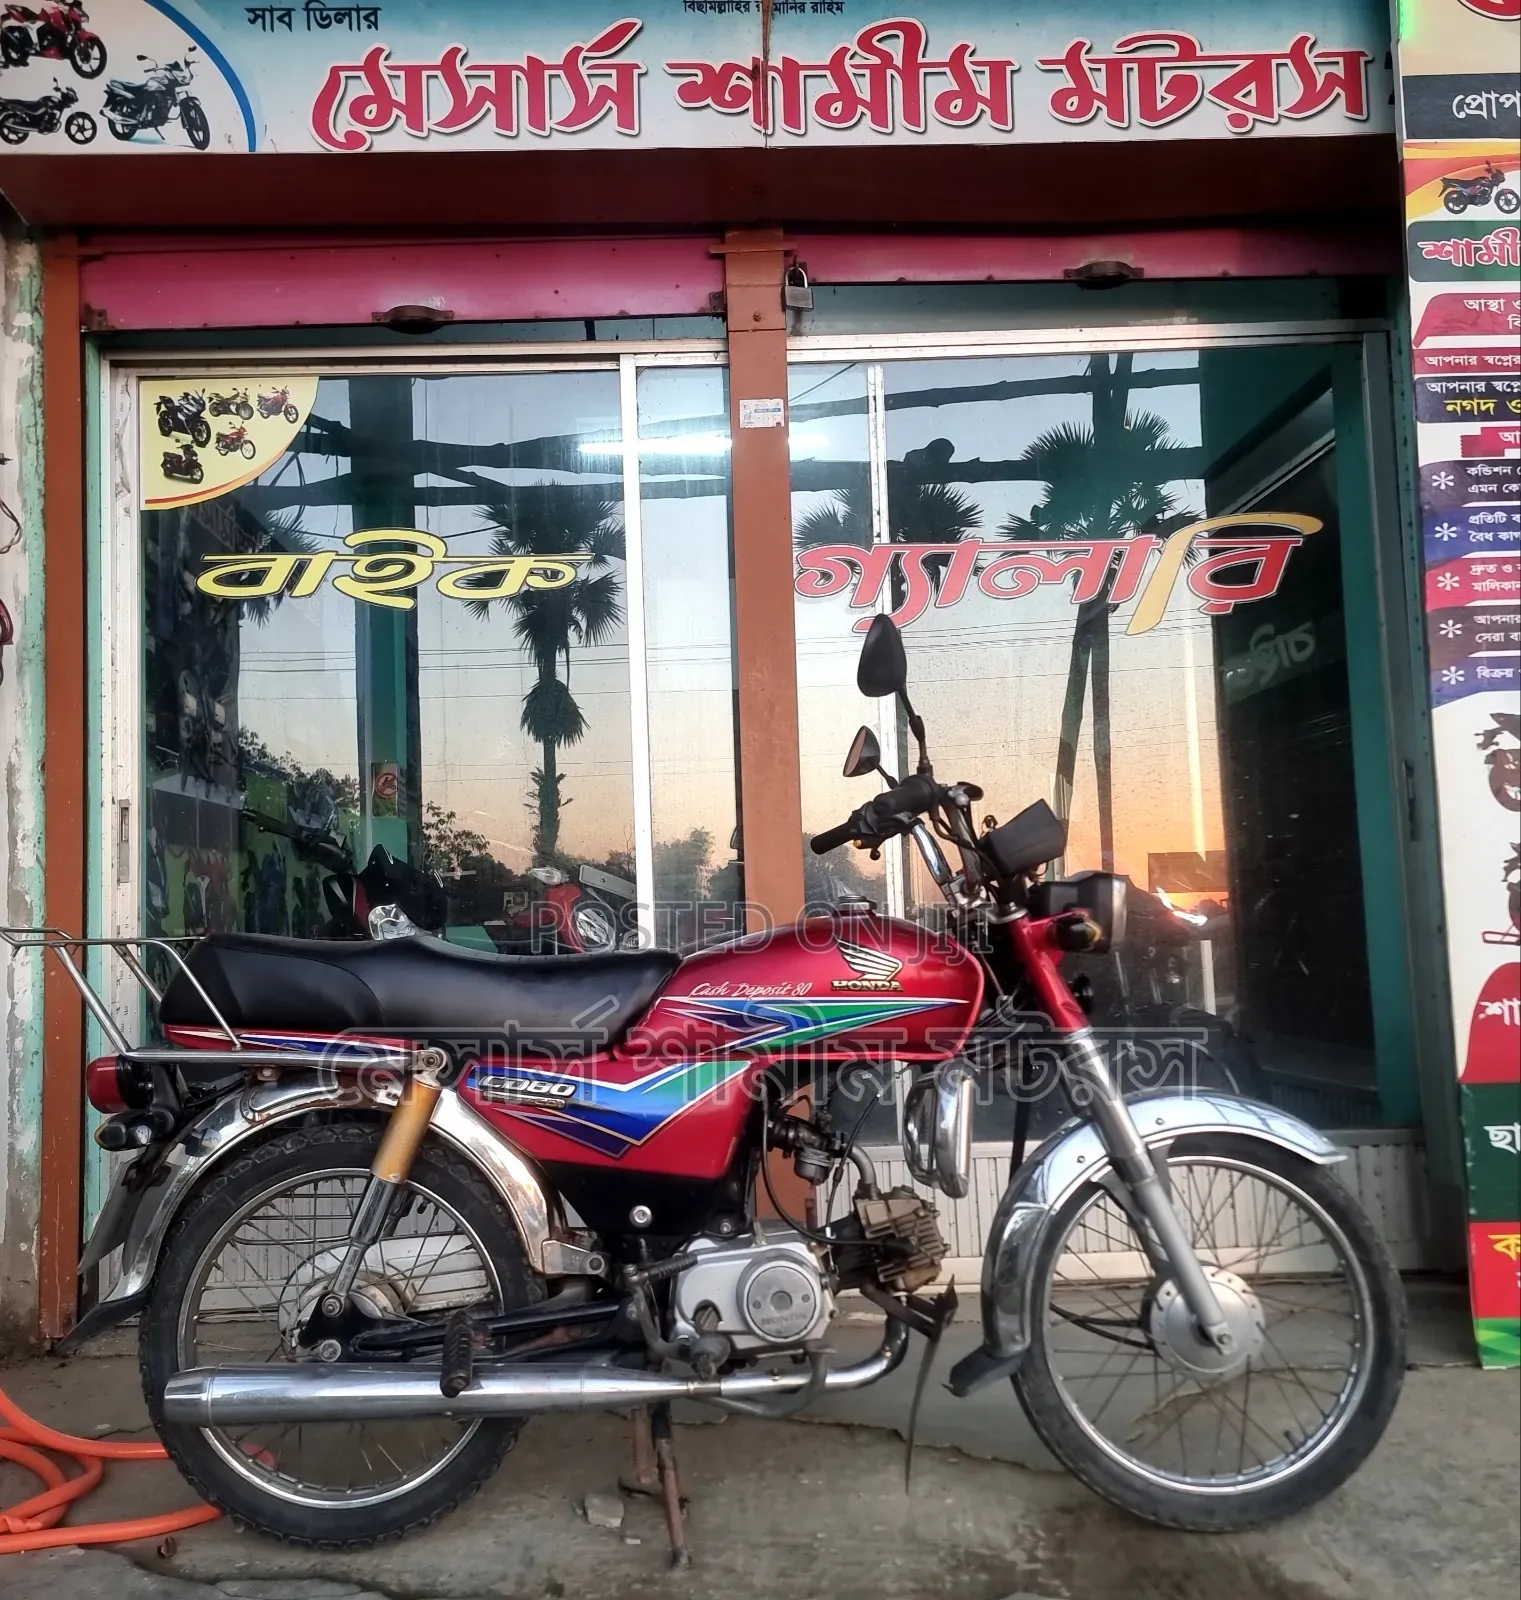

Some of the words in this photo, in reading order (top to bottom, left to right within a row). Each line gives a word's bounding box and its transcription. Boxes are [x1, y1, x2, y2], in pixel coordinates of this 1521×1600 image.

[244, 4, 296, 33] সাব
[301, 0, 382, 33] ডিলার
[312, 18, 645, 152] মেসার্স
[664, 17, 1018, 135] শামীম
[1037, 31, 1370, 133] মটরস
[1463, 298, 1506, 314] আস্থা
[1424, 355, 1478, 367] আপনার
[1425, 381, 1486, 394] আপনার
[1443, 398, 1498, 416] নগদ
[1468, 483, 1498, 494] এমন
[195, 527, 595, 611] বাইক
[794, 511, 1324, 635] গ্যালারি
[688, 981, 730, 998] Cash
[731, 981, 794, 1000] Deposit
[791, 982, 813, 996] 80
[831, 979, 904, 992] HONDA
[479, 1075, 577, 1097] CD80
